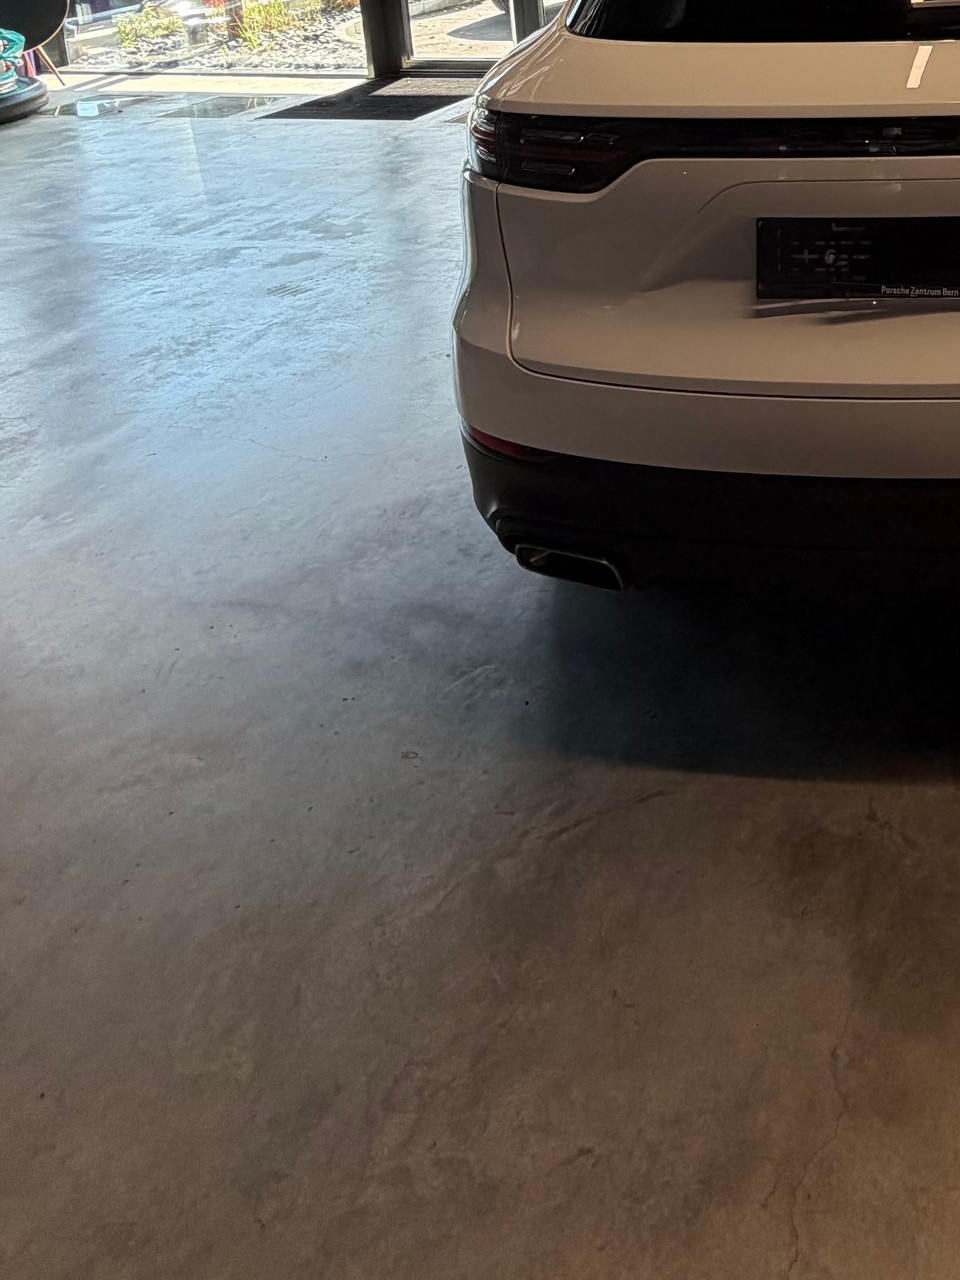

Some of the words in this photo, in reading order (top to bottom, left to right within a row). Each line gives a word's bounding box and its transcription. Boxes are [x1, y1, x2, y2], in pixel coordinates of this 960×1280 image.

[881, 285, 910, 295] Porsche
[910, 286, 941, 297] Zentrum
[942, 287, 959, 296] Bern
